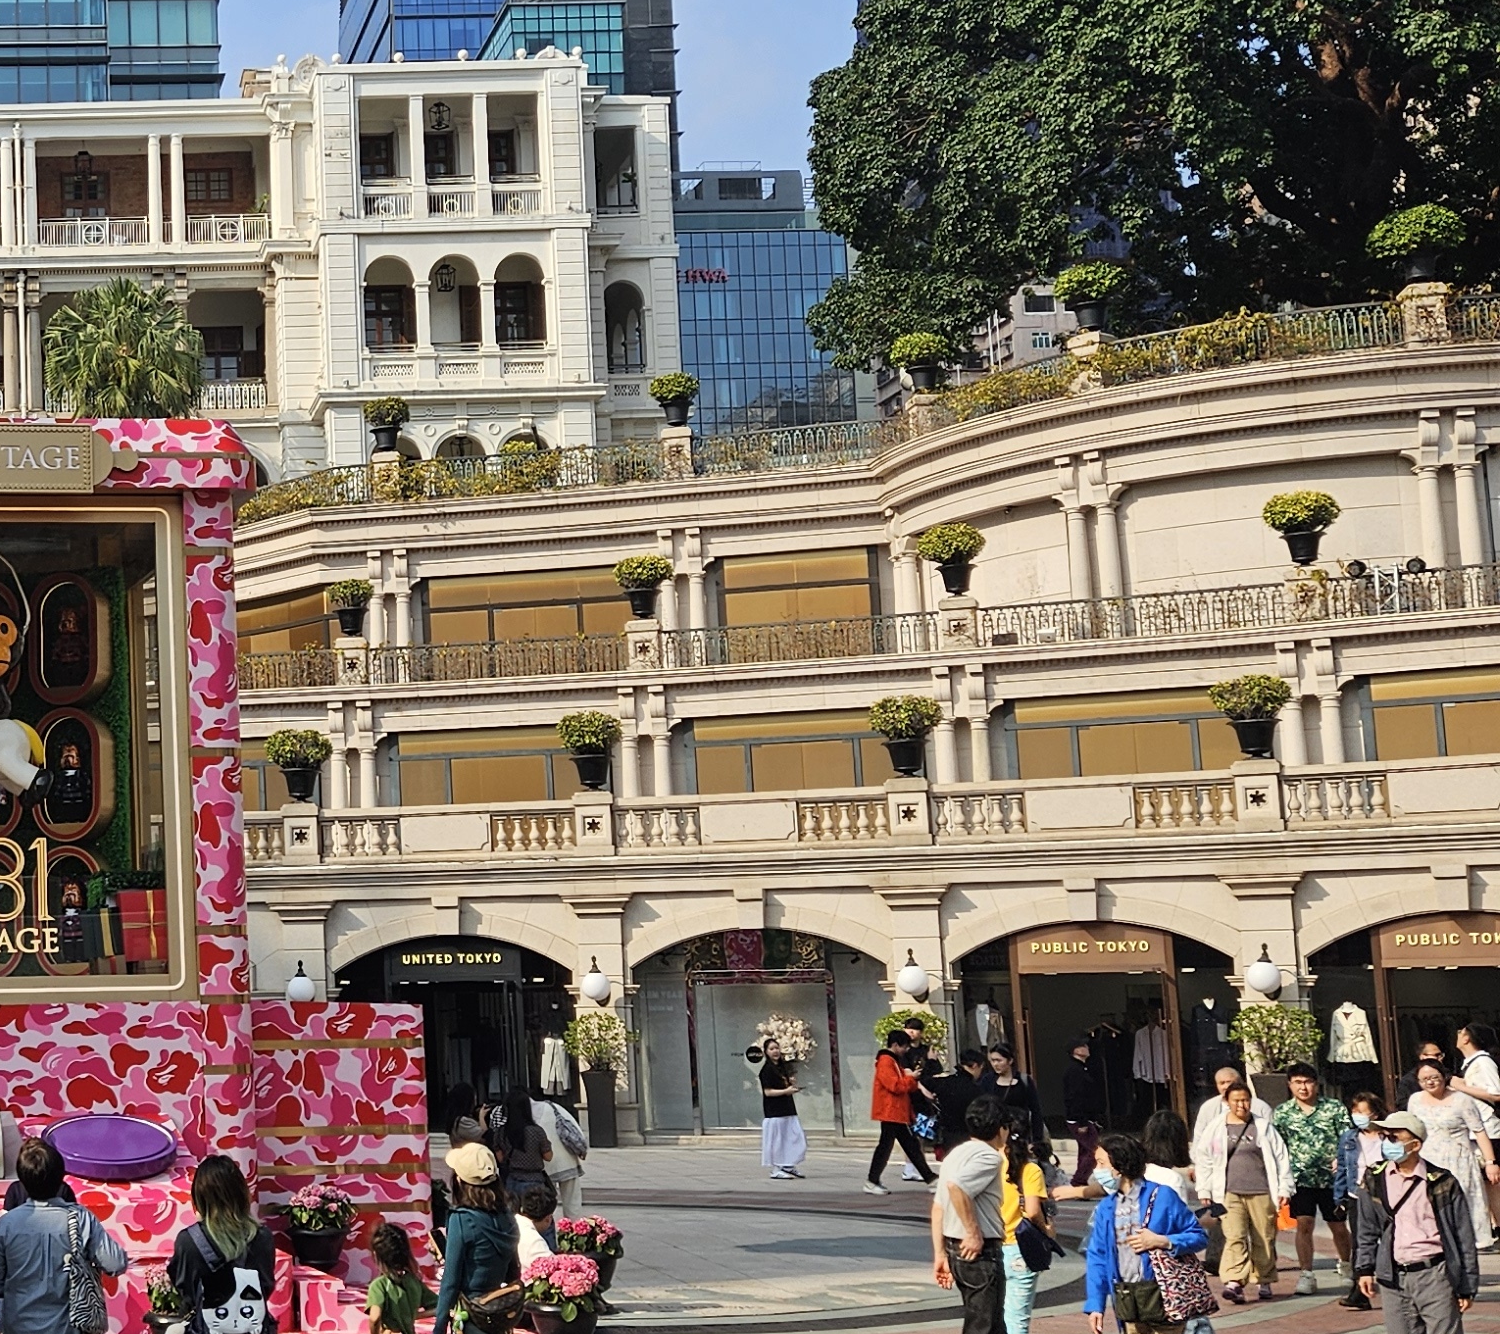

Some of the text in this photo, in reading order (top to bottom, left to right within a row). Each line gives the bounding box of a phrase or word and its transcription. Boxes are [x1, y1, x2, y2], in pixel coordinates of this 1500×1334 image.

[1395, 932, 1461, 947] PUBLIC
[1030, 940, 1150, 954] PUBLIC TOKYO
[402, 952, 502, 965] UNITED TOKYO
